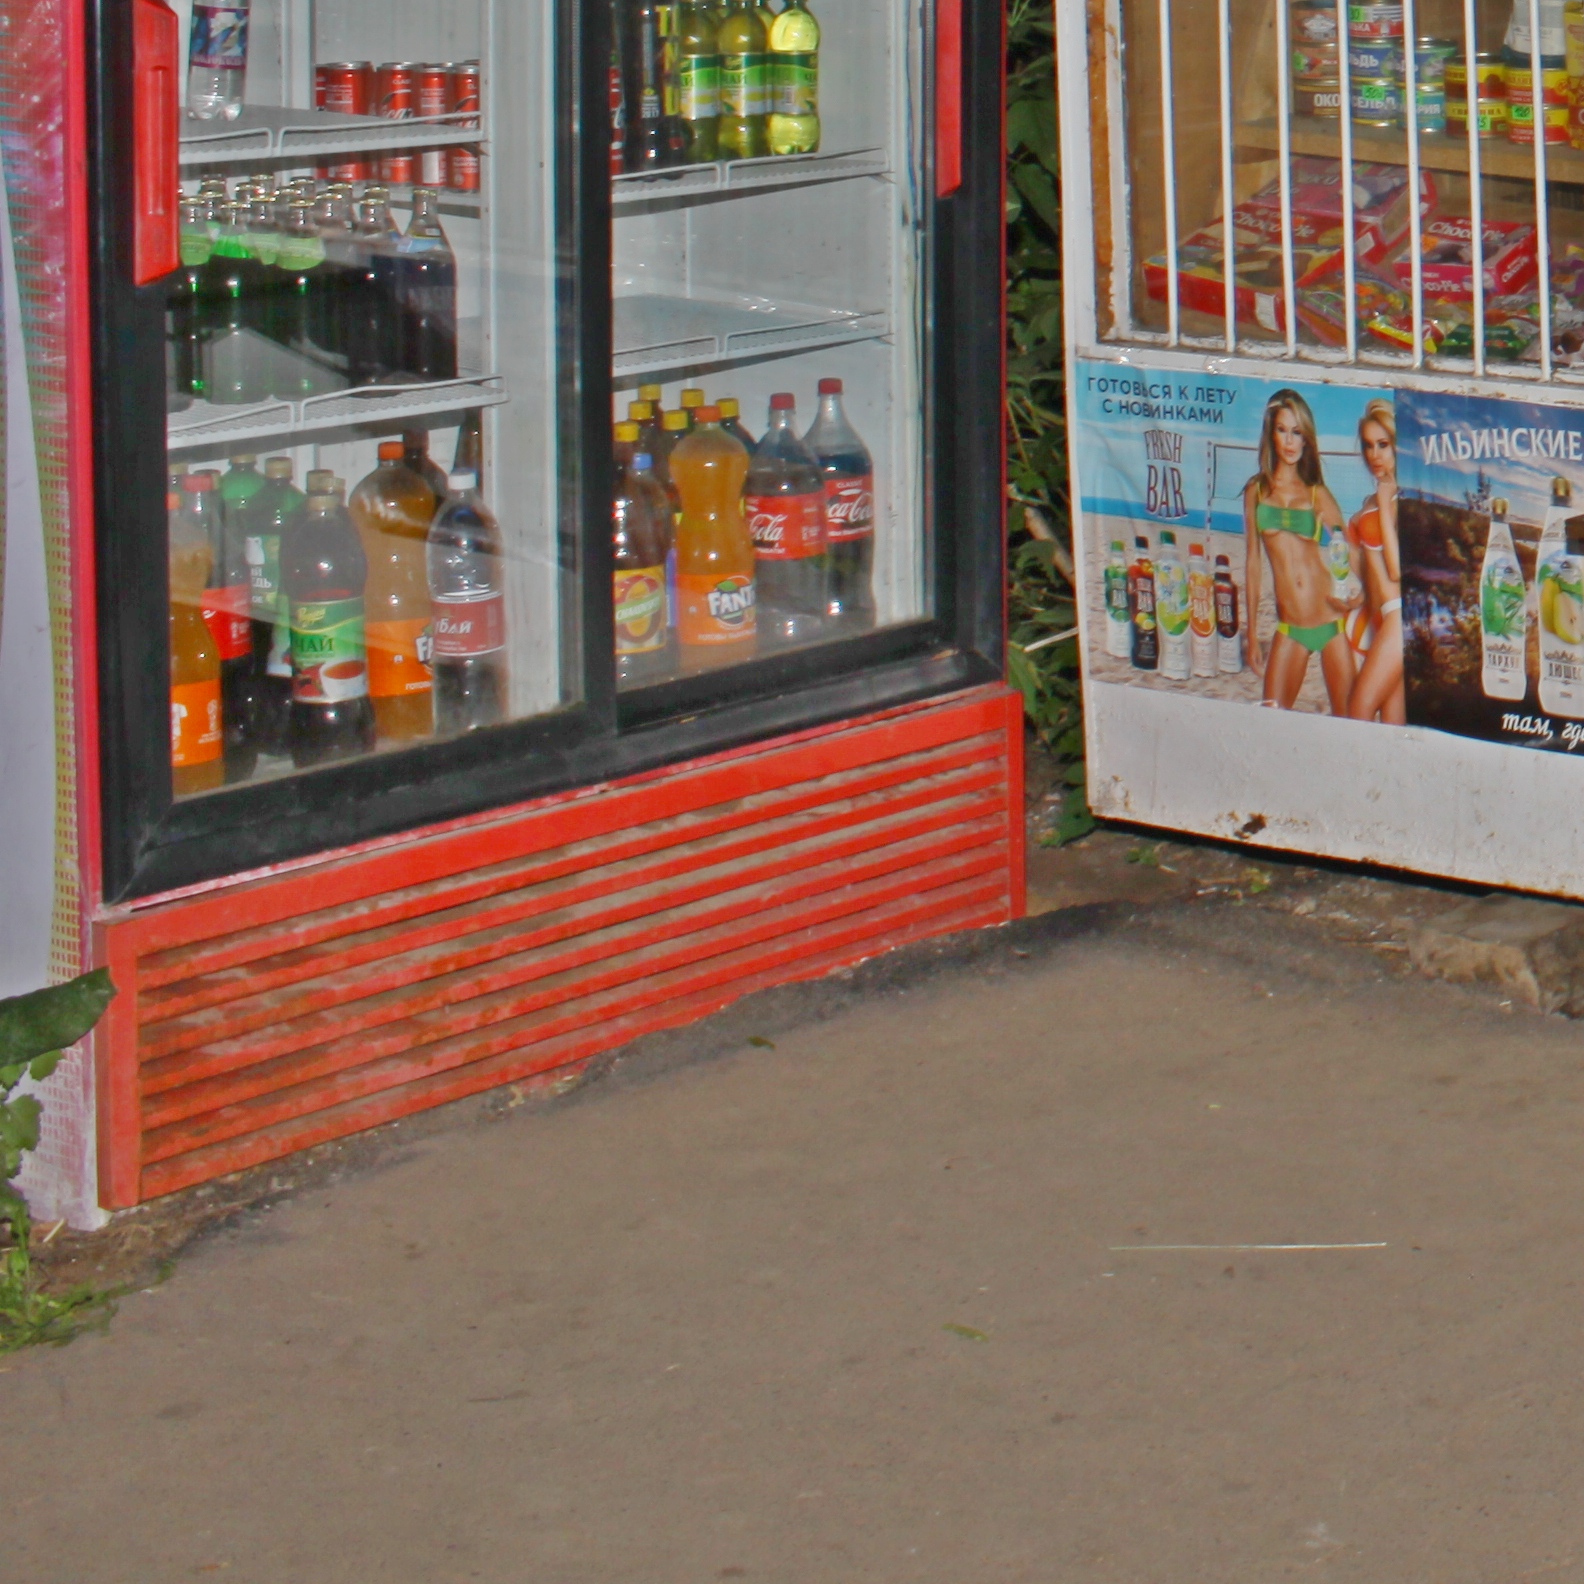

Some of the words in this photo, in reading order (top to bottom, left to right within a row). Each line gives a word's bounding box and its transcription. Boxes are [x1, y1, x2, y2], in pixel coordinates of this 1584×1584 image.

[1401, 276, 1461, 294] Coco-Pie
[1087, 377, 1172, 399] ГОТОВЬСЯ
[1179, 386, 1189, 399] К
[1195, 387, 1238, 405] ЛЕТУ
[1102, 399, 1113, 414] С
[1119, 402, 1223, 424] НОВИНКАМИ
[1144, 430, 1184, 463] FRESH
[1420, 427, 1583, 465] ИЛЬИНСКИЕ
[1146, 464, 1188, 518] BAR
[708, 588, 756, 617] FANT
[1502, 712, 1553, 741] там,
